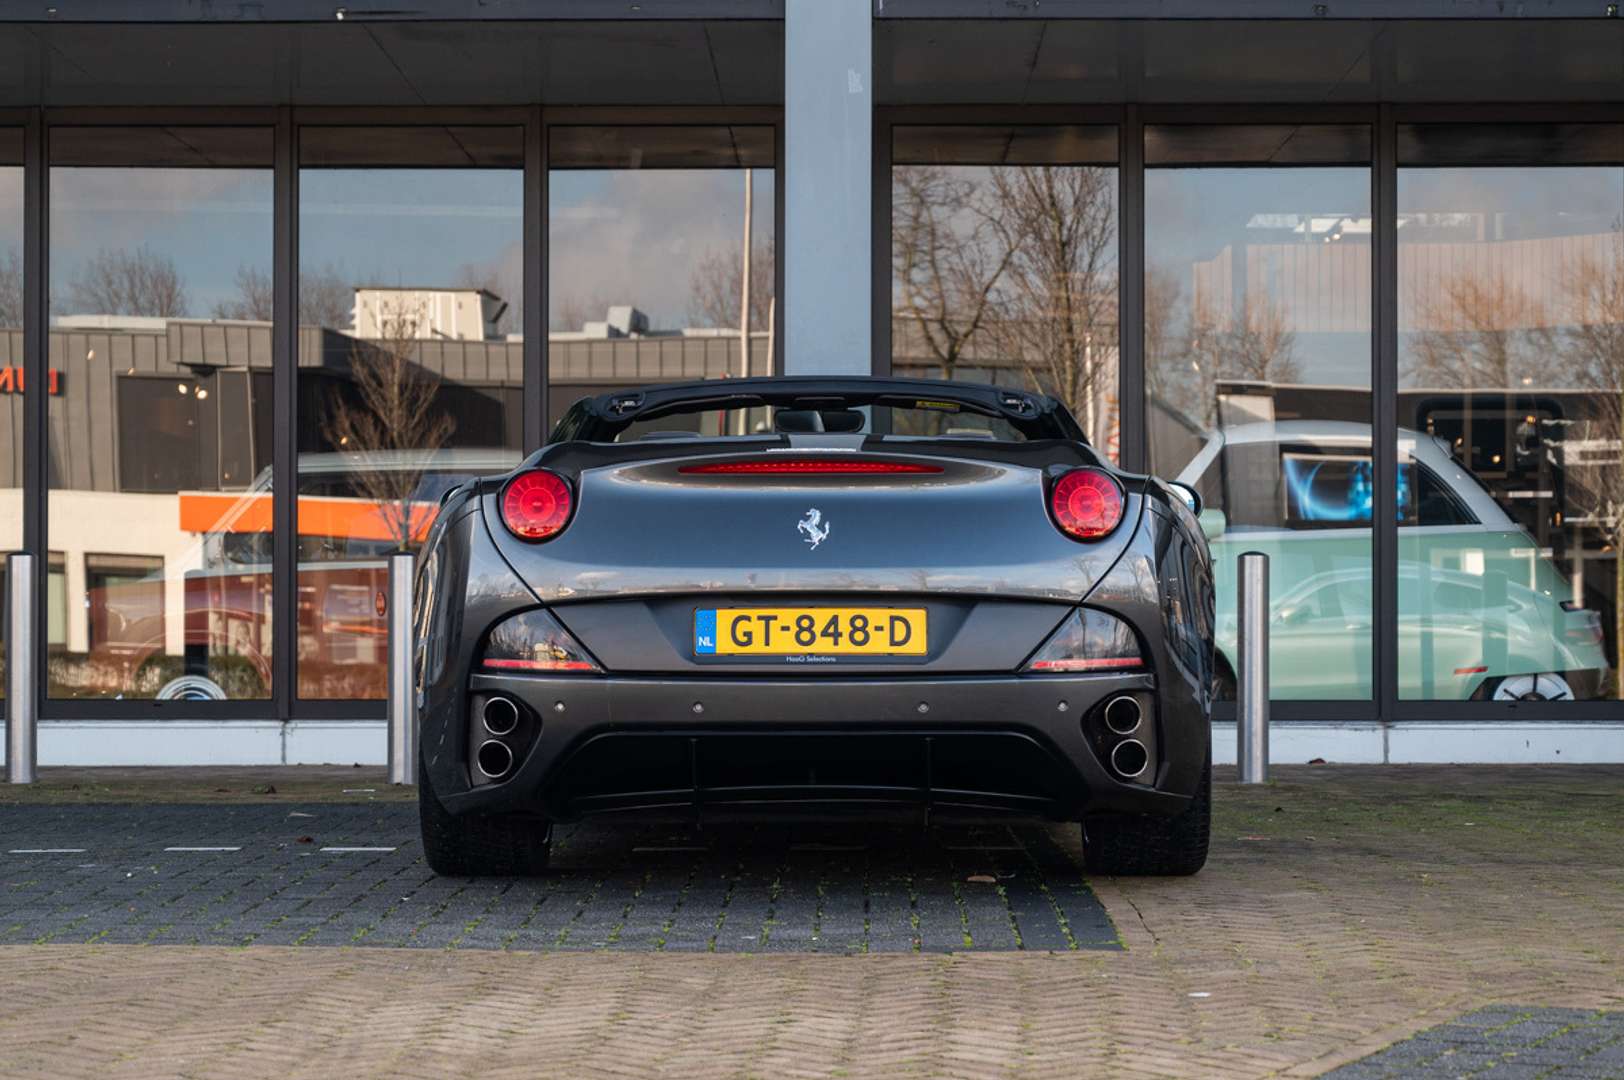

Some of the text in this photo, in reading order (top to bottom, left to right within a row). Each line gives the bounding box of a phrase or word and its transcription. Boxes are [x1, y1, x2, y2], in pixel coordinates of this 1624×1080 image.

[730, 614, 912, 647] GT-848-D
[698, 636, 713, 647] NL
[807, 655, 836, 663] Selections
